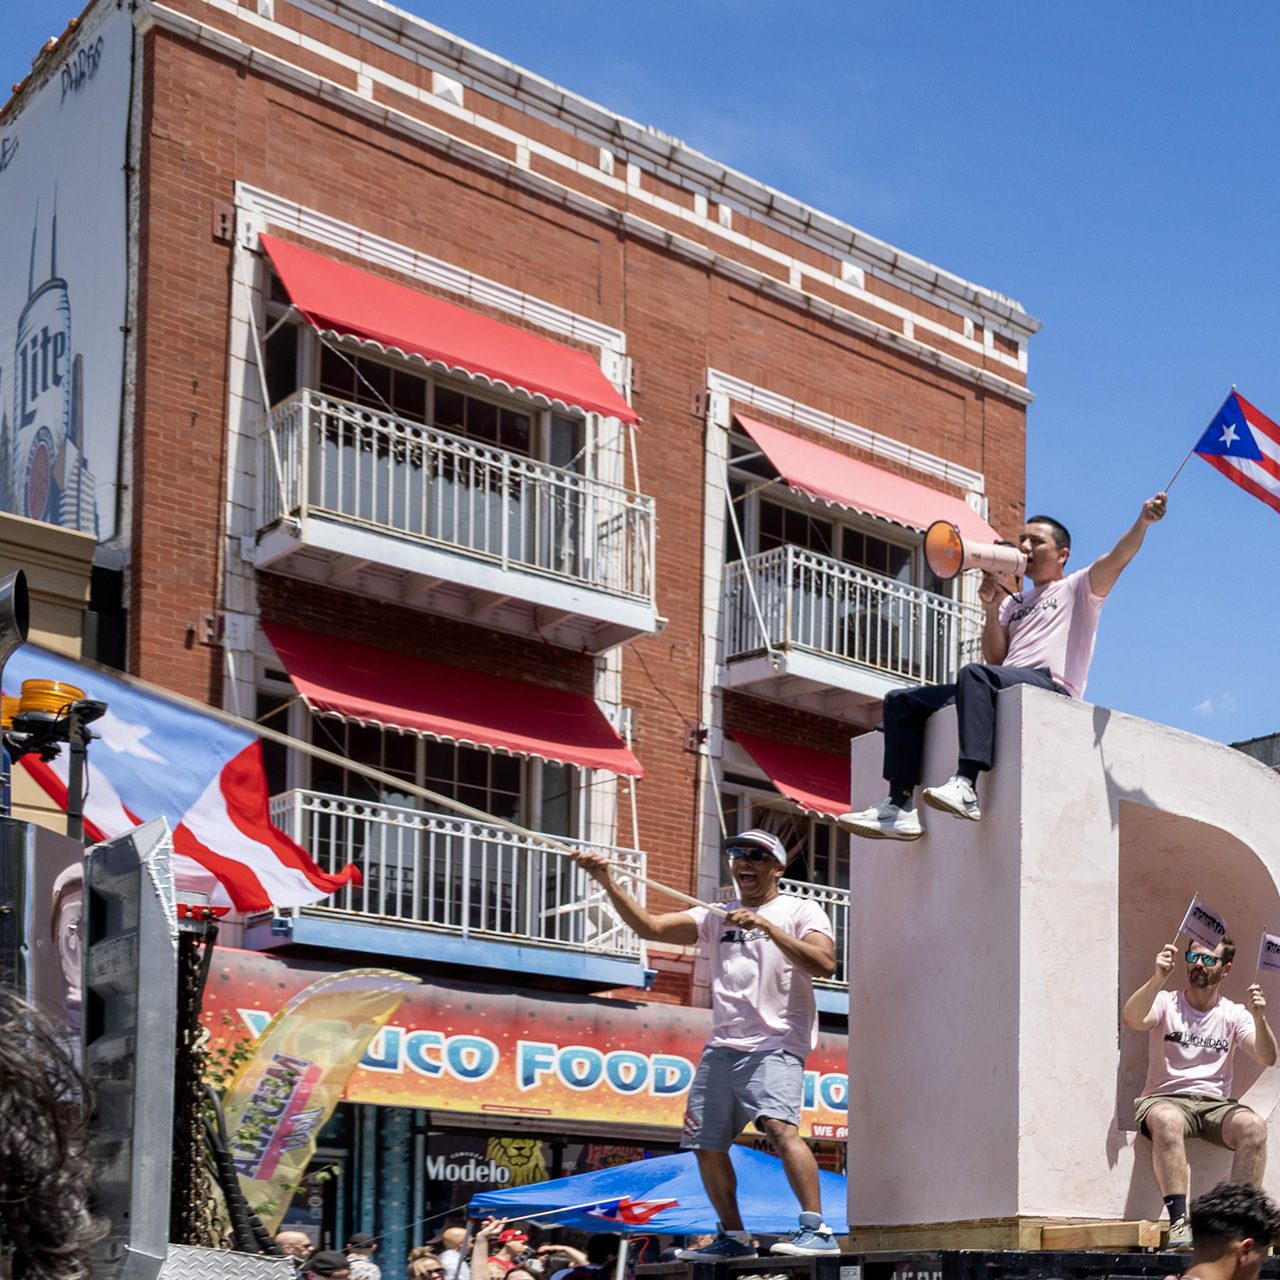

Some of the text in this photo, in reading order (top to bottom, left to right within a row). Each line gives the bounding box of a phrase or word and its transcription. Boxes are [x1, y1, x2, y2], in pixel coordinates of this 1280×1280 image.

[20, 325, 66, 430] Lite
[516, 1040, 696, 1097] FOOD
[813, 1125, 834, 1137] WE
[426, 1155, 511, 1184] Modelo
